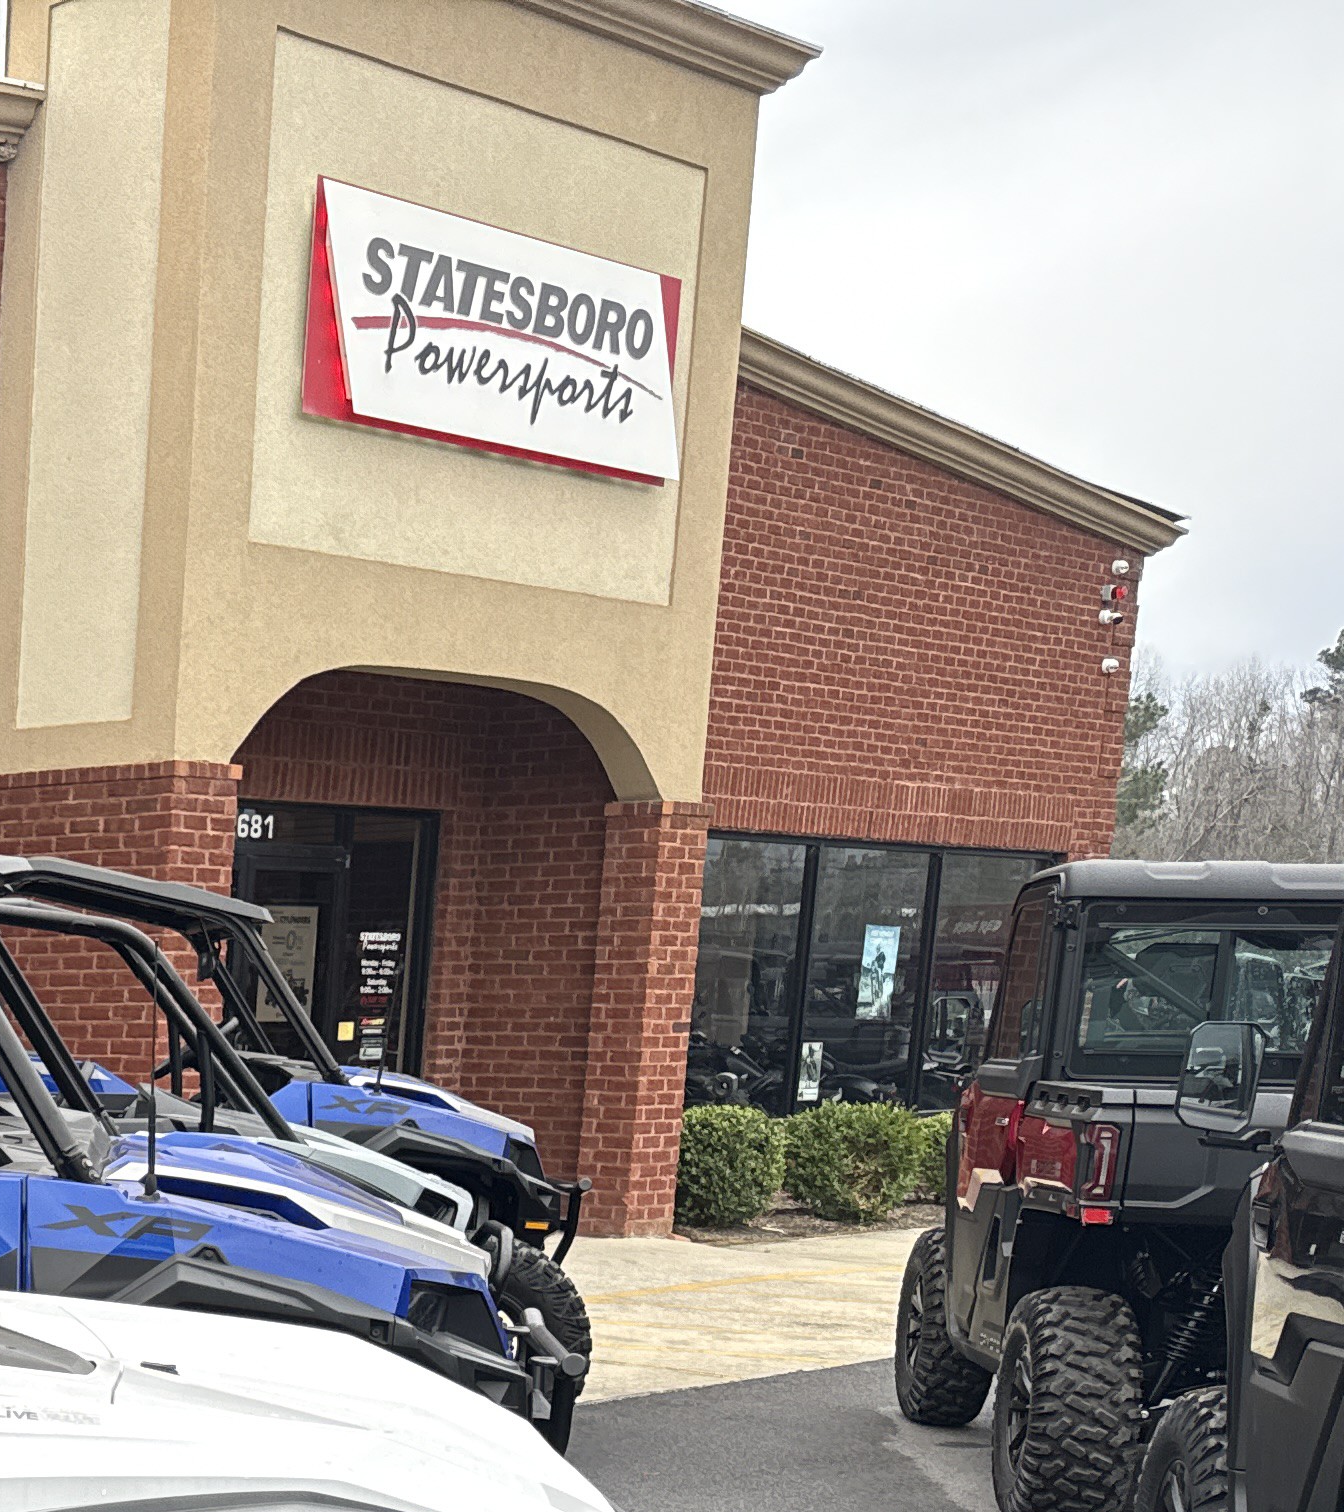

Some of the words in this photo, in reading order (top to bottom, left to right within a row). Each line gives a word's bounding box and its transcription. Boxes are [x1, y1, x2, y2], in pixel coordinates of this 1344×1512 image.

[362, 237, 654, 361] STATESBORO
[384, 293, 634, 425] Powersports
[237, 813, 275, 839] 681
[318, 1094, 412, 1116] XP
[33, 1203, 215, 1242] XP
